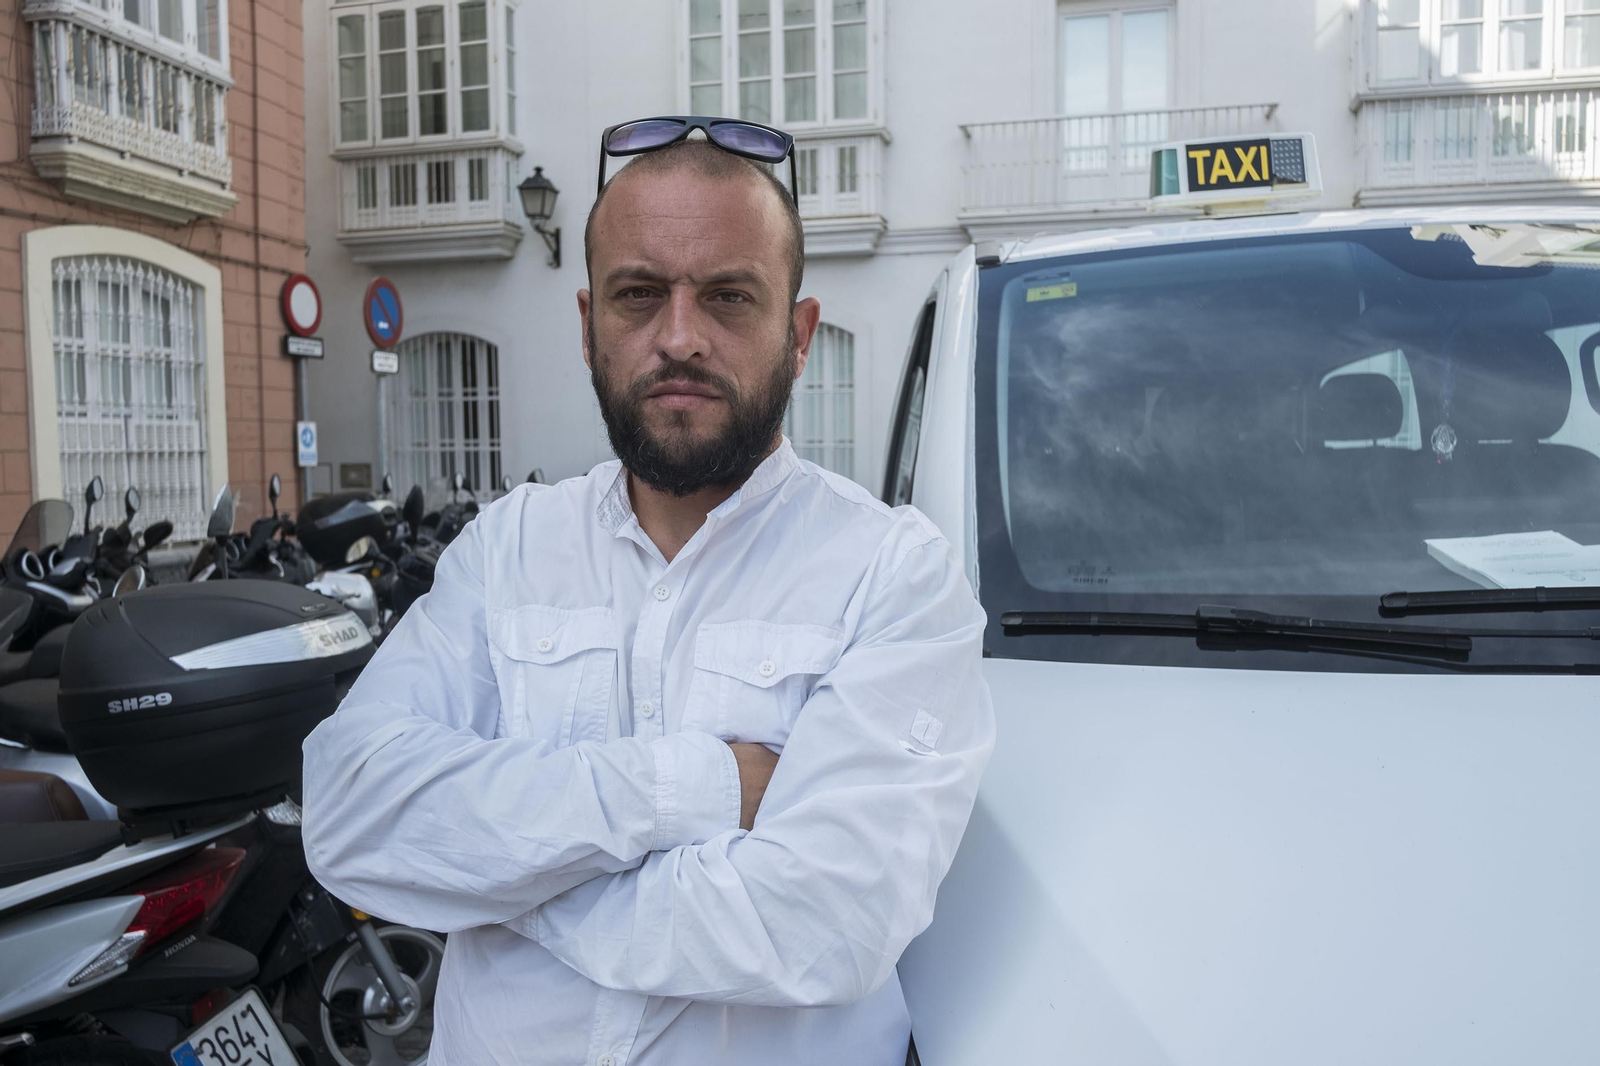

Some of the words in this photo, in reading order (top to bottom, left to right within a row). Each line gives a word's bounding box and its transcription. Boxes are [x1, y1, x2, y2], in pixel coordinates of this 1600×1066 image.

[1188, 145, 1270, 186] TAXI
[318, 625, 359, 648] SHAD
[107, 692, 173, 714] SH29
[164, 934, 197, 957] HONDA
[196, 1003, 269, 1066] 3641
